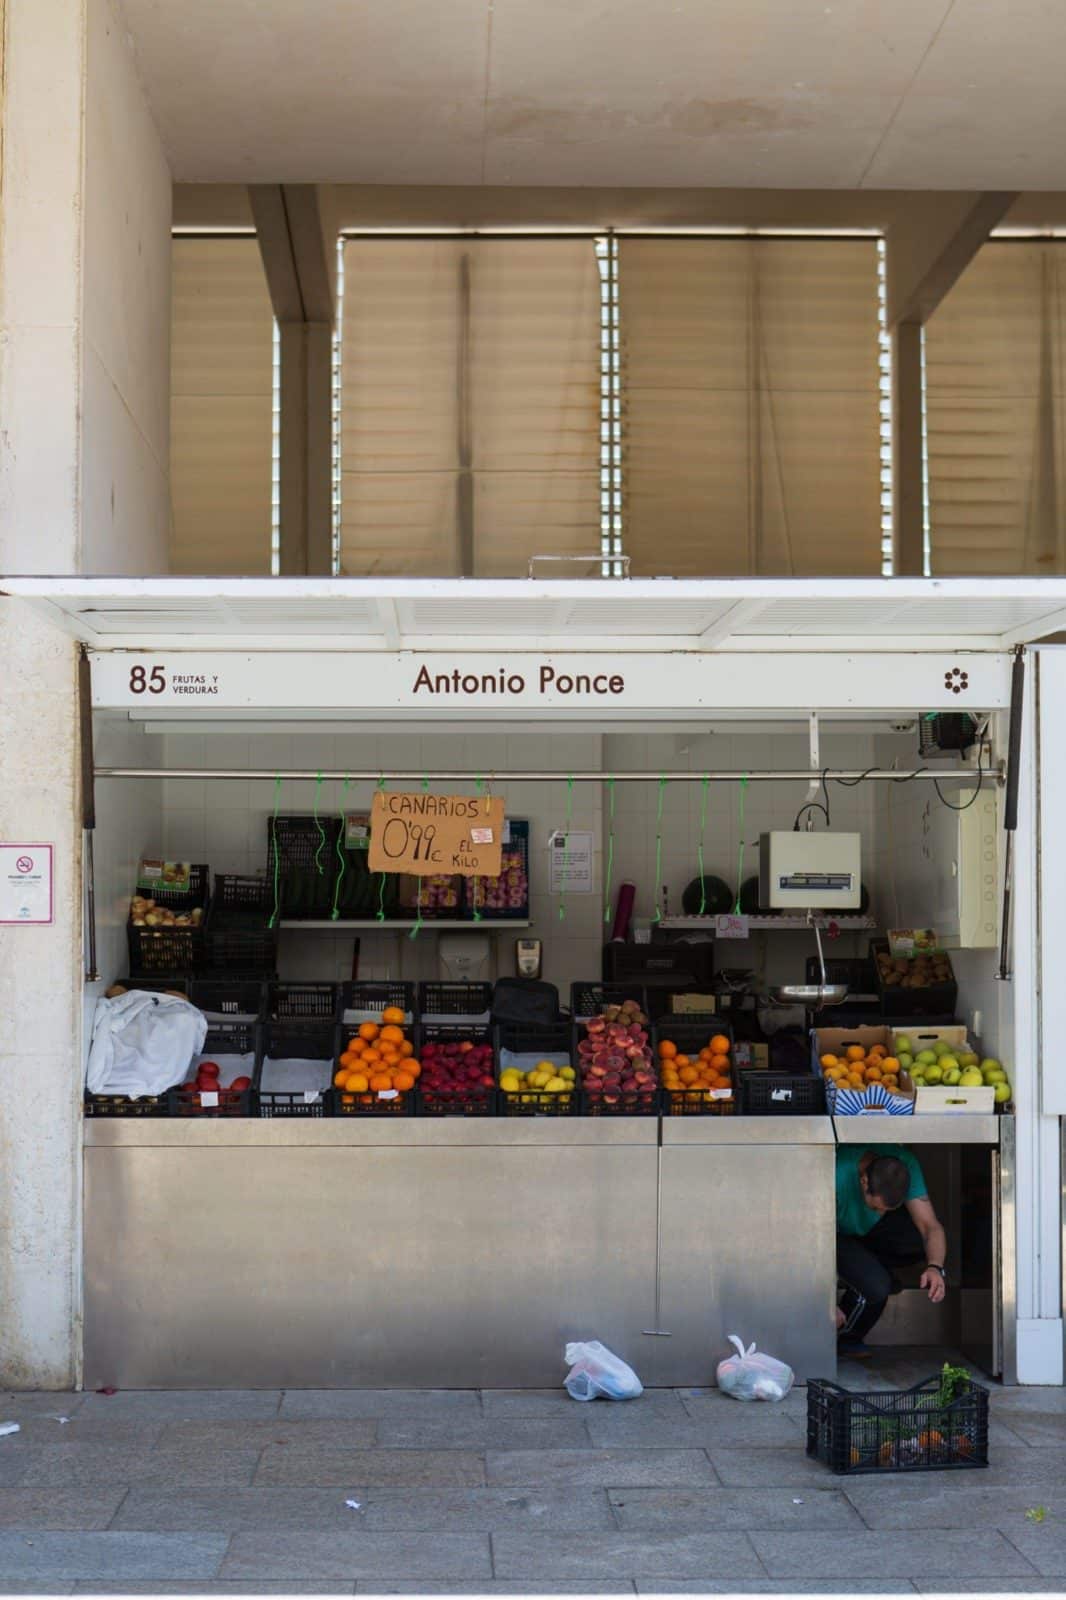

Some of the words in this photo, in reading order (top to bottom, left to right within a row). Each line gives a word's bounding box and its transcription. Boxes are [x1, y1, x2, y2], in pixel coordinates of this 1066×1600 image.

[129, 665, 167, 694] 85
[172, 675, 206, 684] FRUTAS
[212, 675, 219, 684] Y
[412, 664, 526, 694] Antonio
[539, 665, 625, 694] Ponce
[172, 685, 219, 695] VERDURAS
[459, 839, 473, 853] EL
